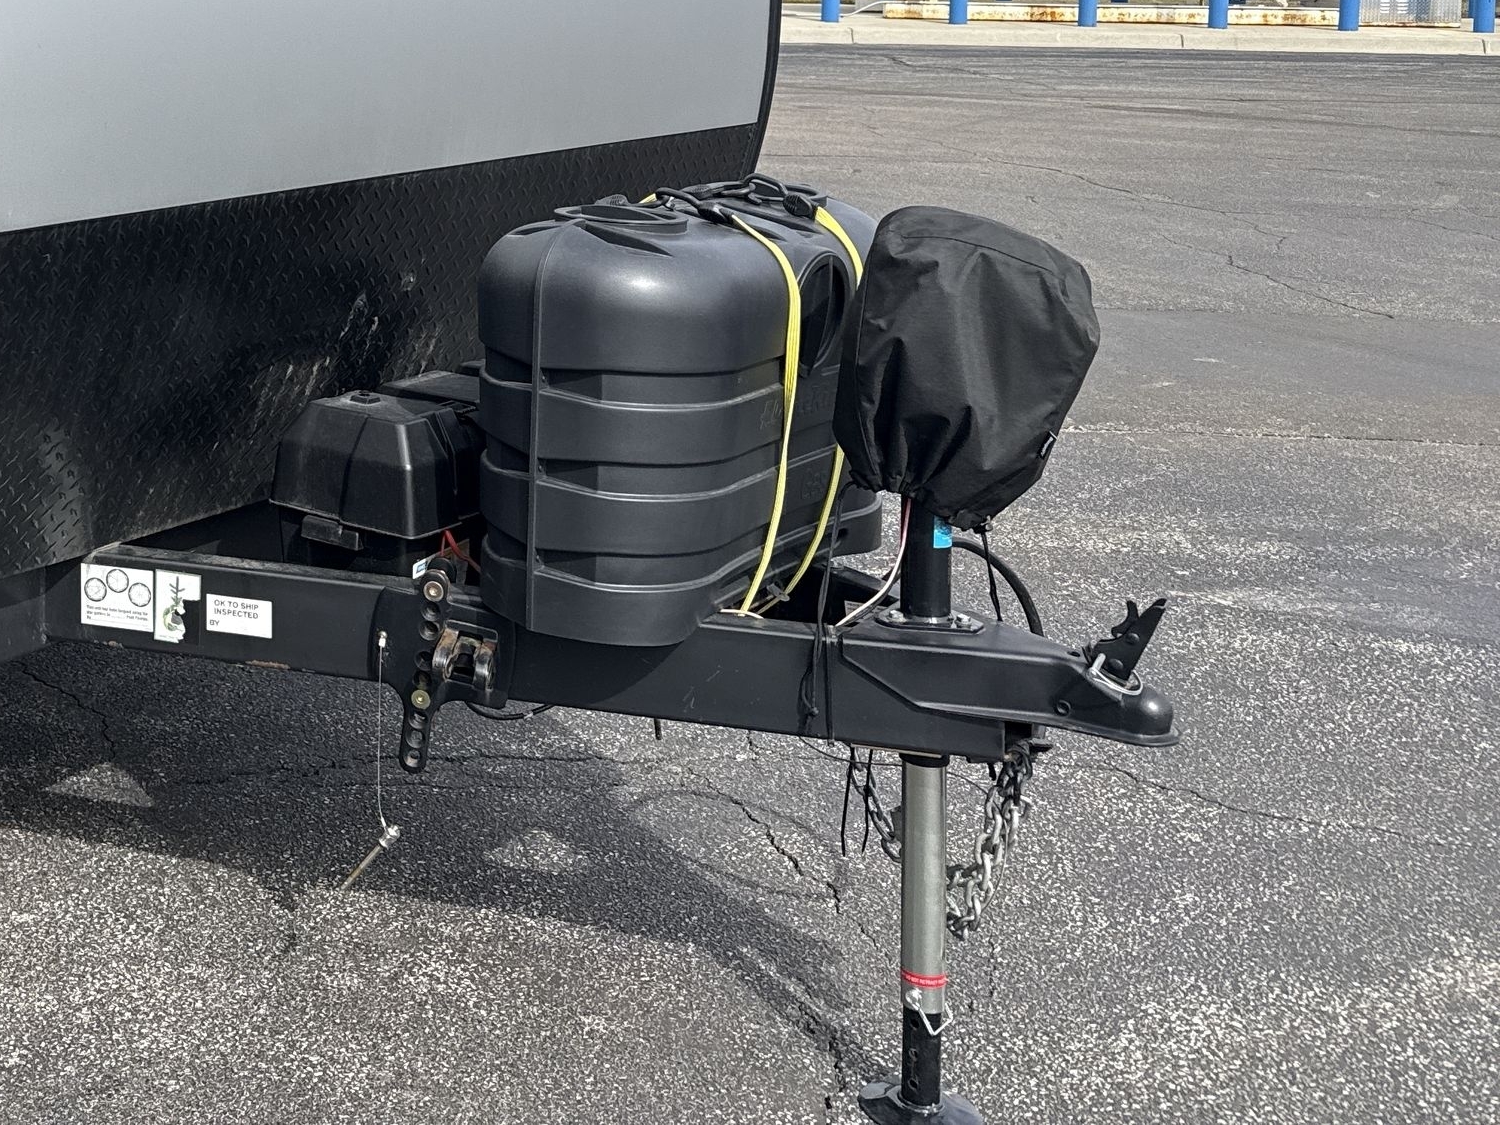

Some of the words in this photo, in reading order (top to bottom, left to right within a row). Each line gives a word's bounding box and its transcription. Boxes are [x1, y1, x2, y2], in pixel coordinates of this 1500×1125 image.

[214, 599, 225, 607] OK
[228, 600, 239, 609] TO
[241, 602, 259, 611] SHIP
[214, 608, 259, 619] INSPECTED
